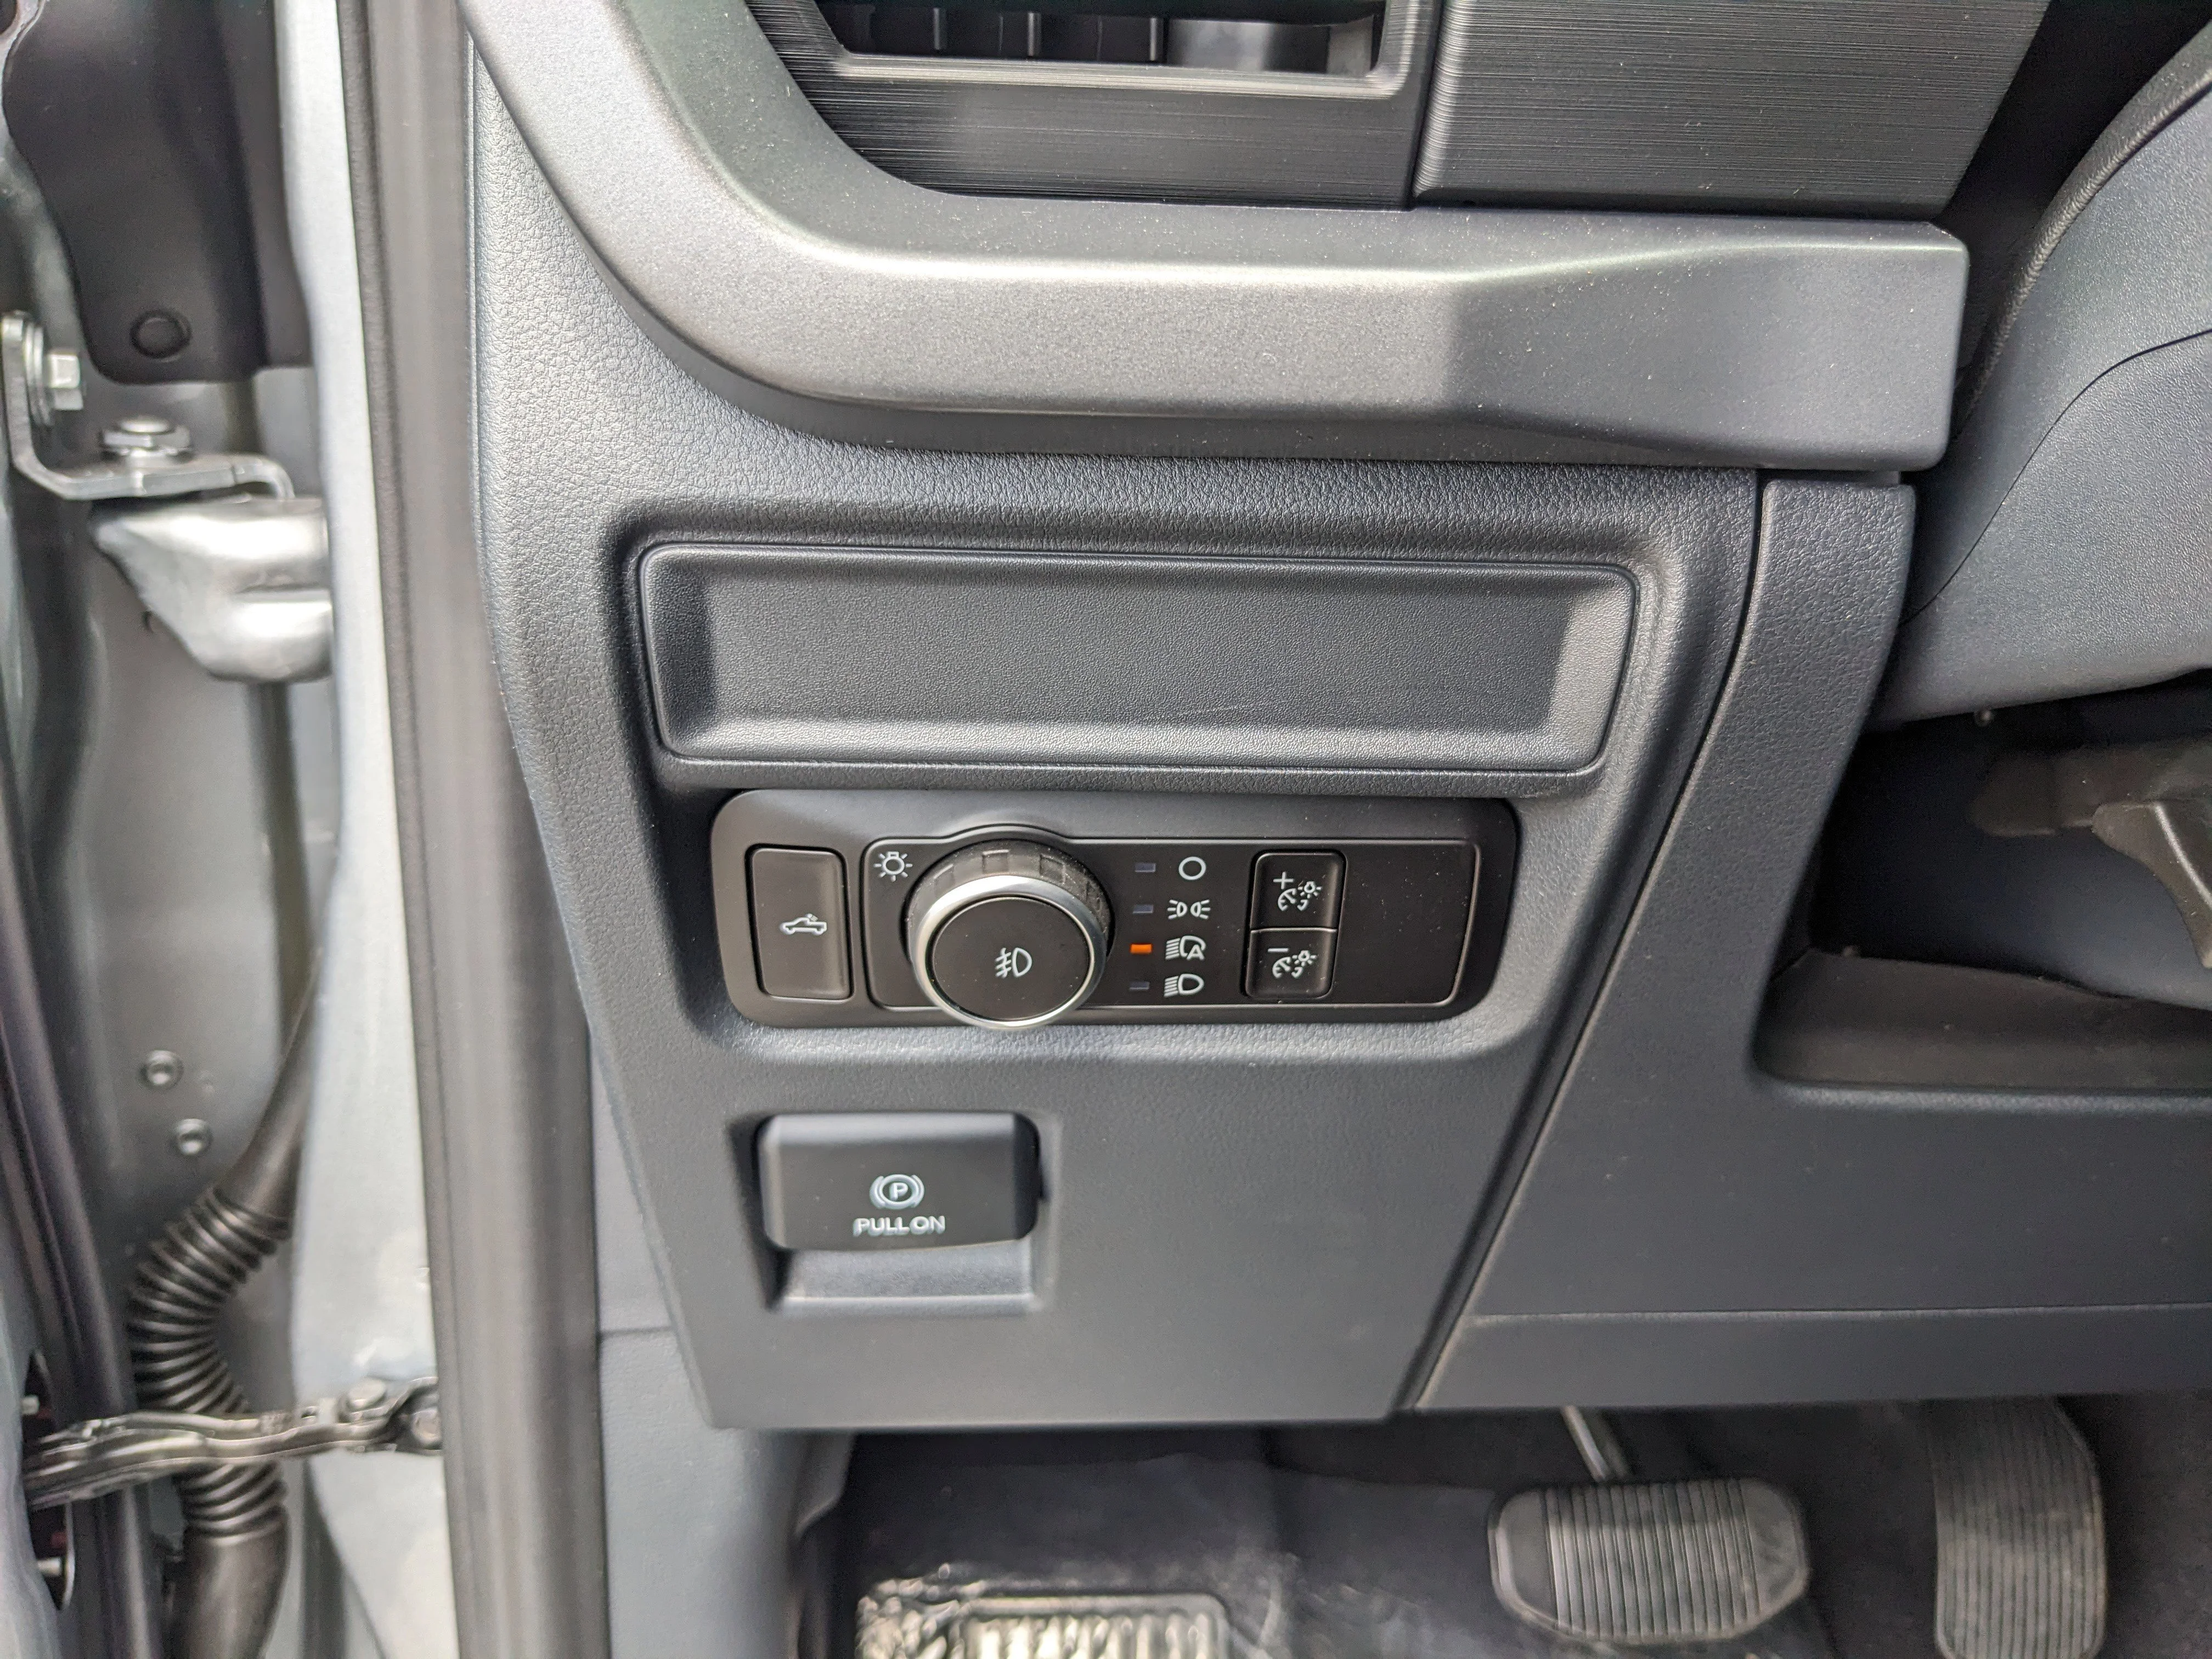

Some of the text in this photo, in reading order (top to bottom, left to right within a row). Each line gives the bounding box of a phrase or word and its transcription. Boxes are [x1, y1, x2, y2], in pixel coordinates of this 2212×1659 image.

[1187, 944, 1205, 961] A
[889, 1182, 908, 1201] P
[853, 1215, 946, 1237] PULL ON
